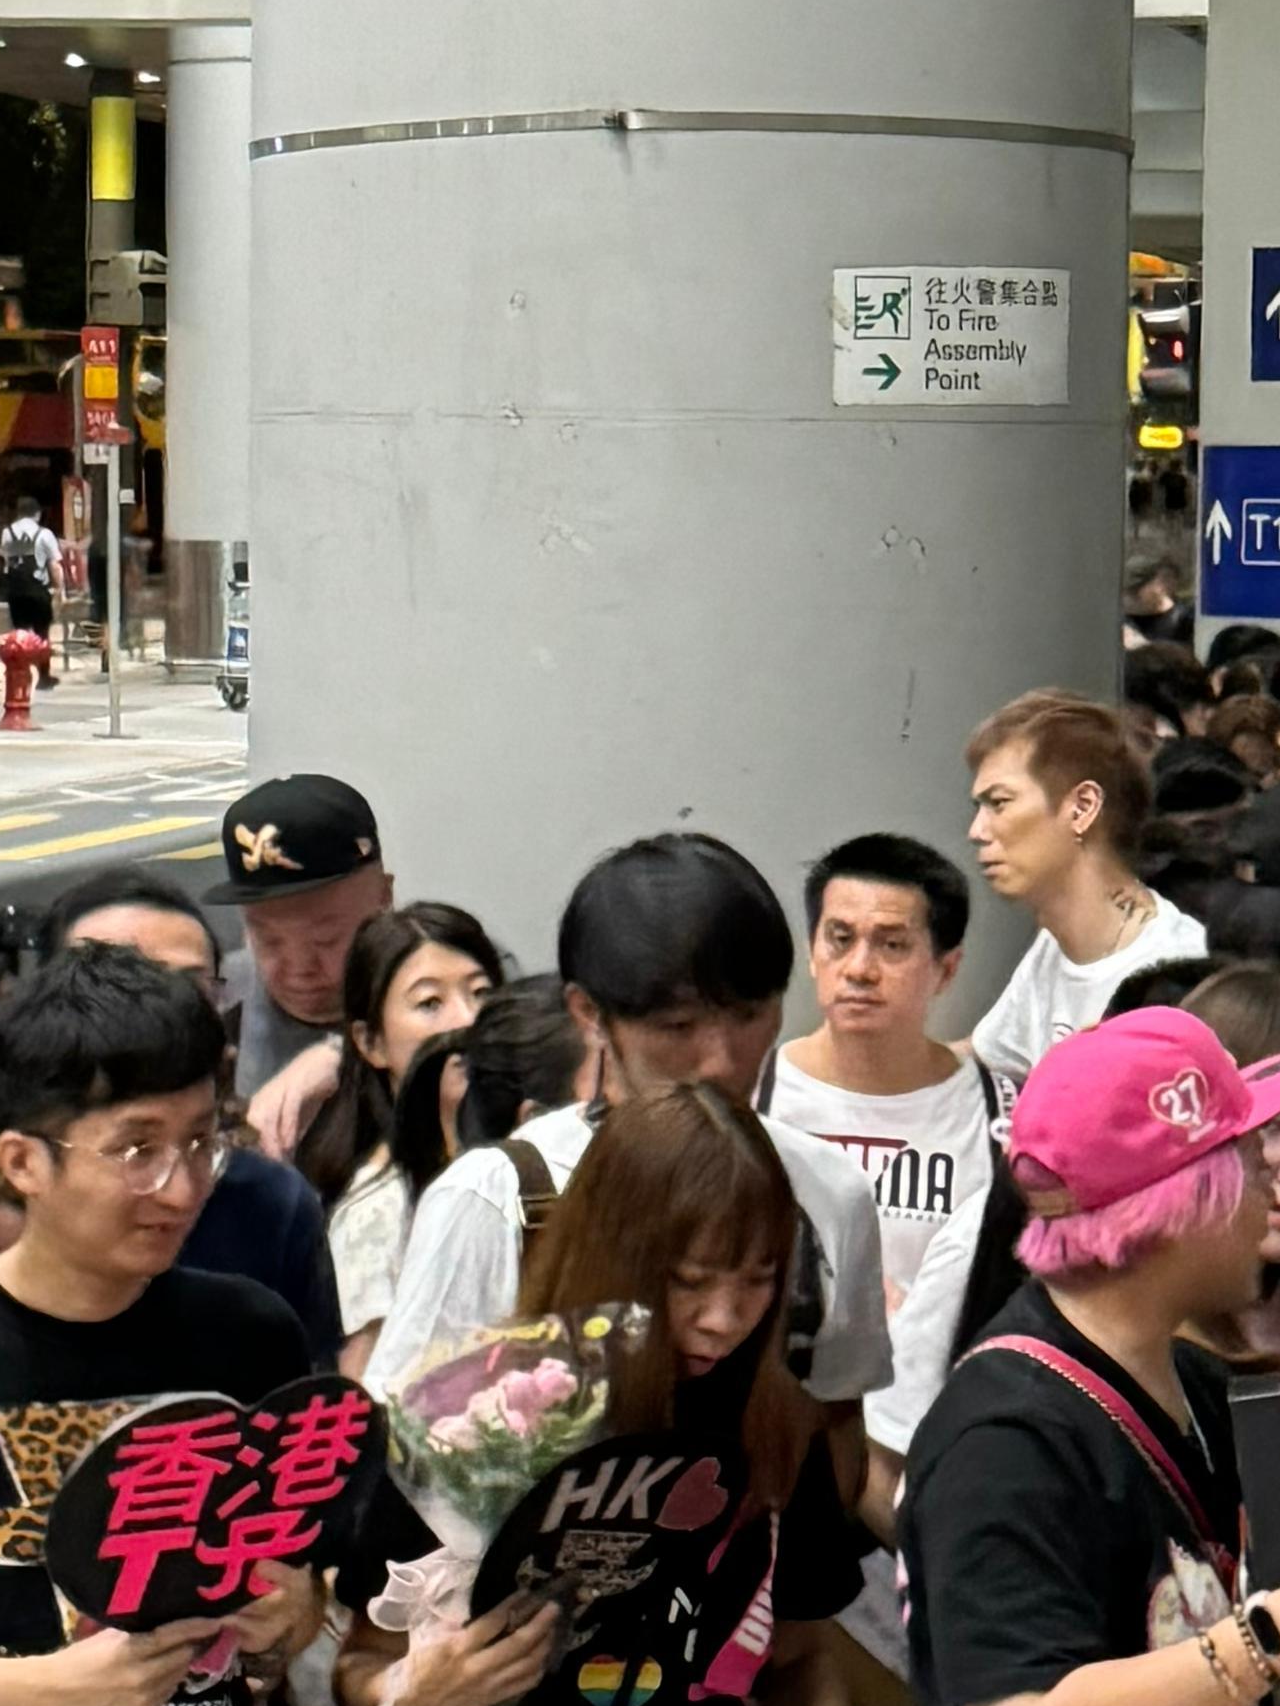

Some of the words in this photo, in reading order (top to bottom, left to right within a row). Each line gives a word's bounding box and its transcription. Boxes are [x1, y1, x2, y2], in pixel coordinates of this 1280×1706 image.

[923, 277, 1058, 307] 往火警集合點
[923, 308, 951, 331] To
[958, 308, 1000, 331] Fire
[923, 337, 1028, 367] Assembly
[924, 366, 982, 391] Point
[1160, 1074, 1203, 1126] 27
[103, 1389, 372, 1531] 香港
[537, 1455, 685, 1534] HK
